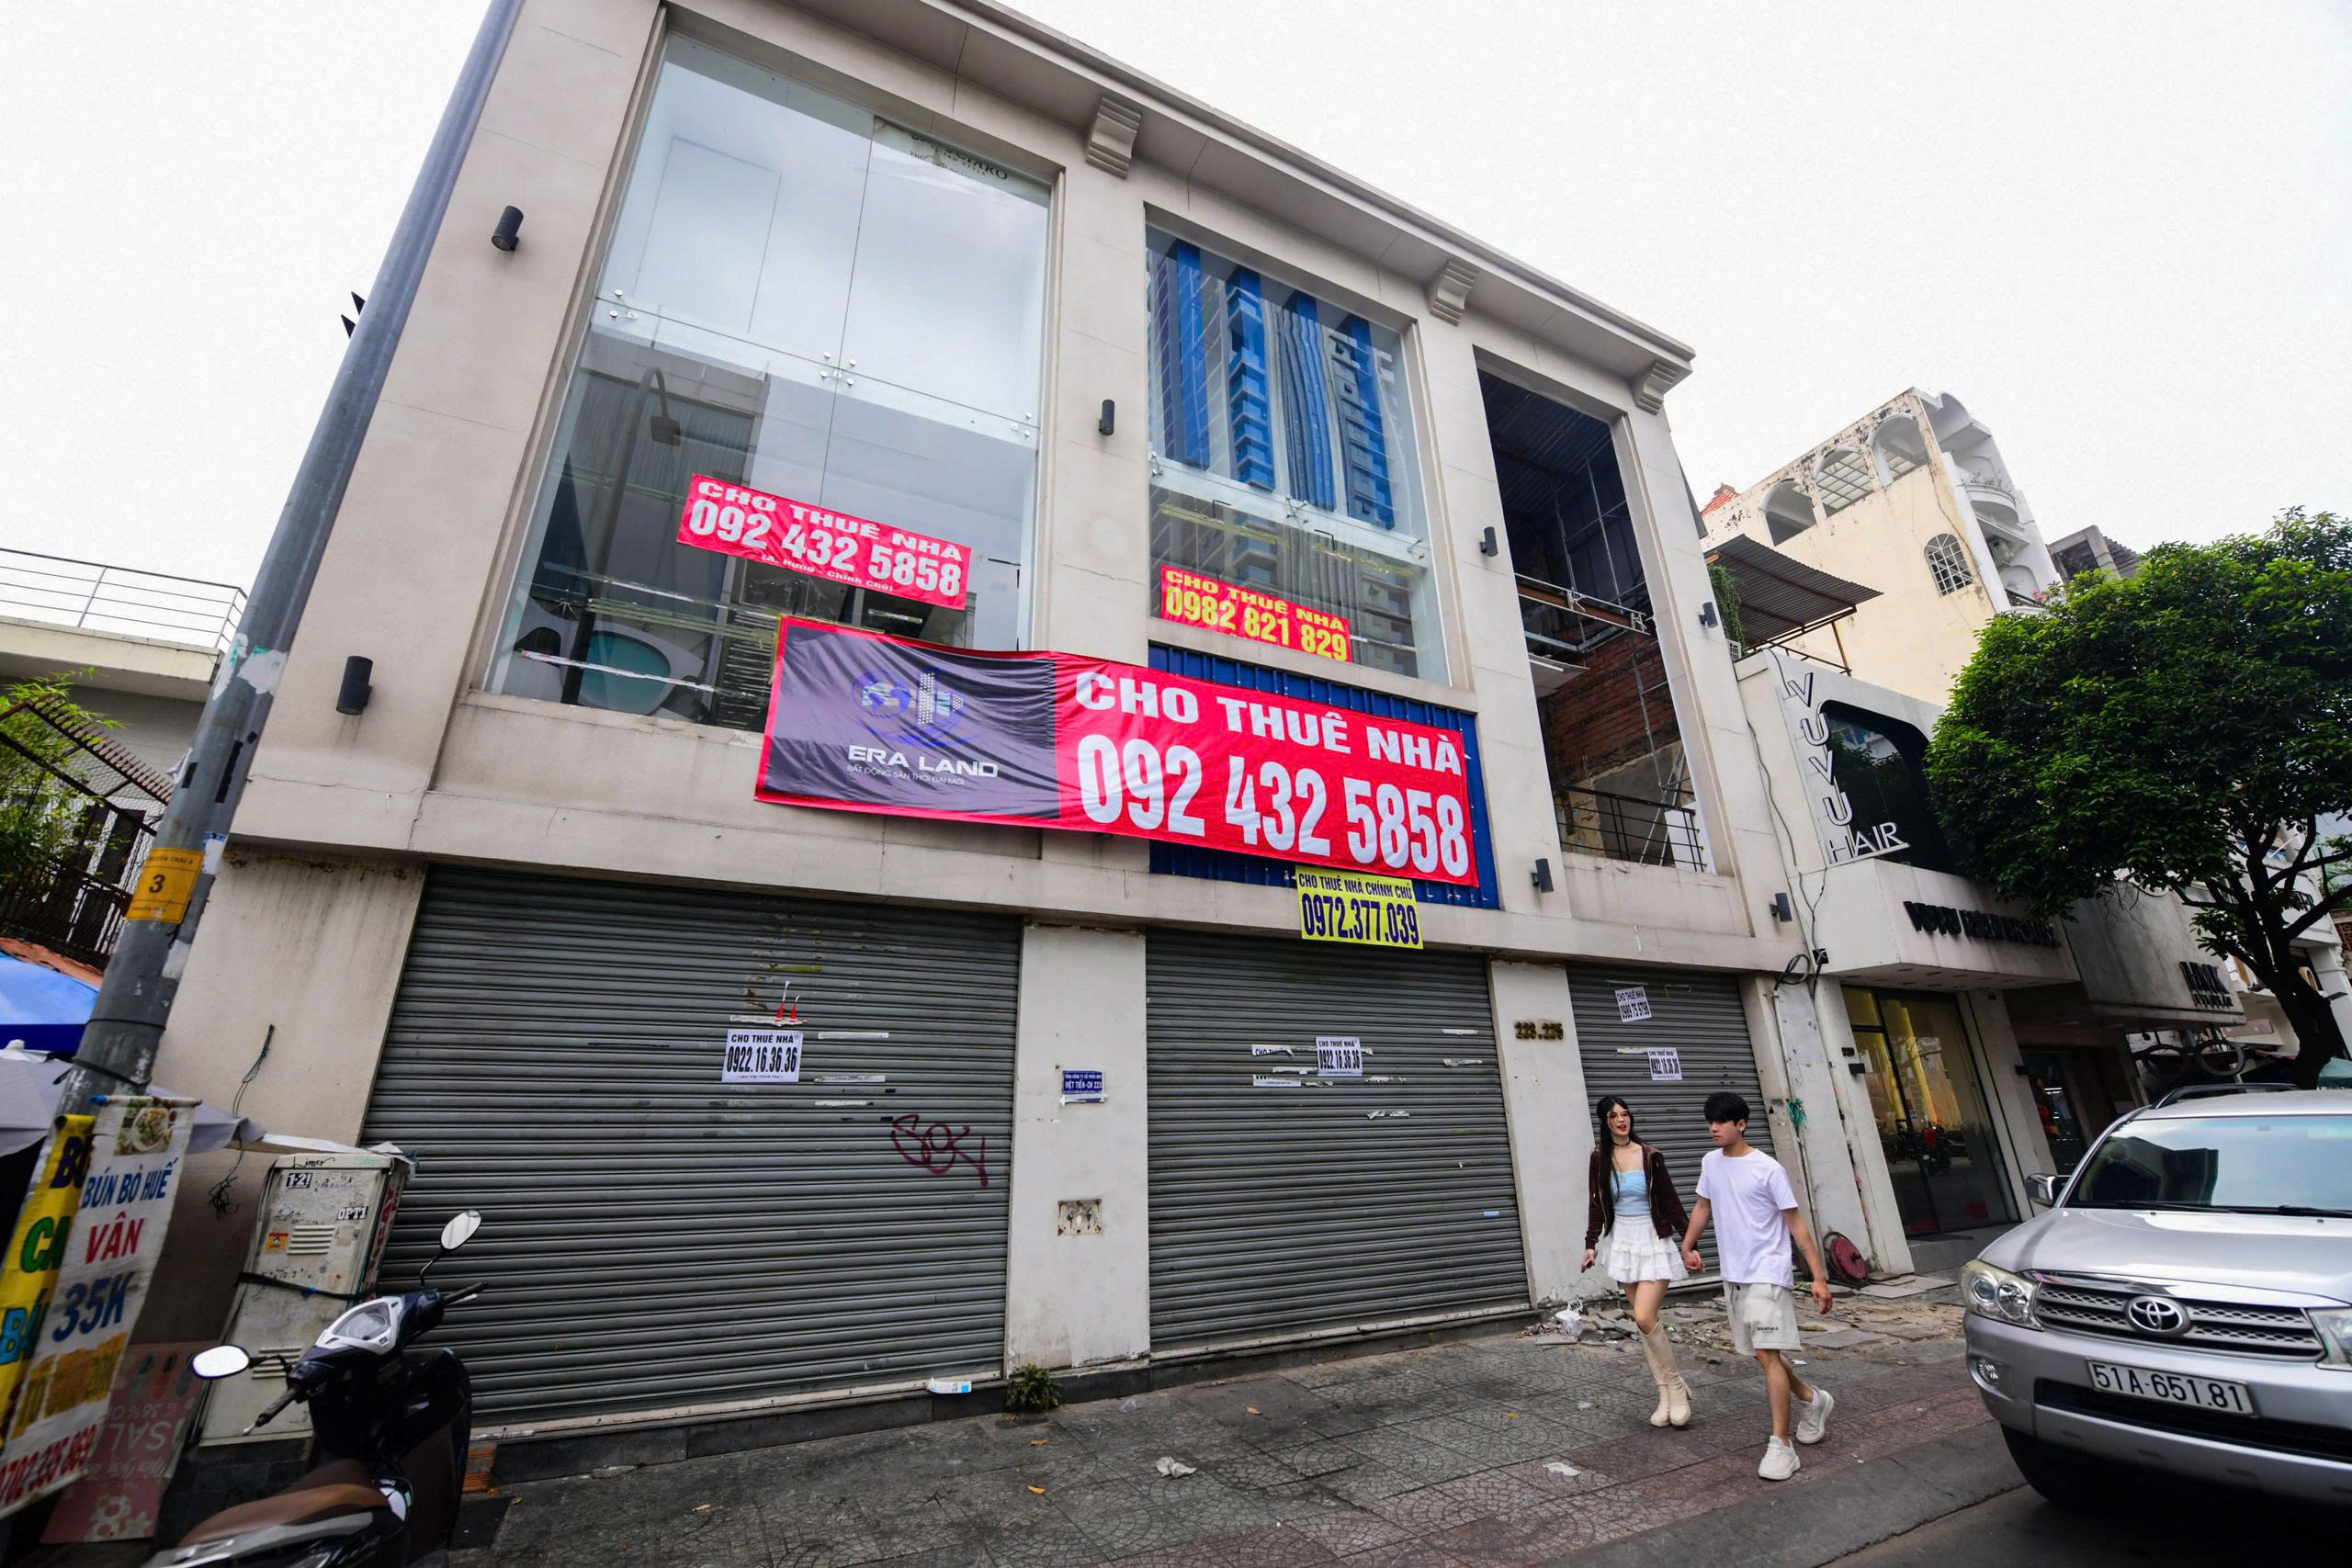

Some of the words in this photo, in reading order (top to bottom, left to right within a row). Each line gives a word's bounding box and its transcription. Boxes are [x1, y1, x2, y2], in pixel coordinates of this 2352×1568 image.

[689, 500, 772, 549] 092
[782, 524, 858, 572] 432
[868, 546, 961, 596] 5858
[698, 481, 776, 513] CHO
[789, 504, 880, 539] THUÊ
[891, 529, 963, 562] NHÀ
[1165, 570, 1219, 594] CHO
[1227, 587, 1289, 615] THUÊ
[1296, 608, 1345, 632] NHÀ
[1166, 586, 1236, 631] 0982
[1244, 607, 1290, 646] 821
[1300, 624, 1348, 661] 829
[1075, 671, 1199, 724] CHO
[1216, 695, 1351, 754] THUÊ
[1366, 726, 1463, 776] NHÀ
[1787, 672, 1853, 826] VUVU
[848, 745, 910, 767] ERA
[919, 756, 999, 777] LAND
[1077, 734, 1205, 838] 092
[1225, 755, 1330, 857] 432
[1343, 776, 1469, 877] 5858
[1828, 822, 1908, 864] HAIR
[149, 874, 165, 893] 3
[1299, 873, 1317, 888] CHO
[1319, 874, 1343, 891] THUÊ
[1344, 877, 1364, 894] NHÀ
[1365, 880, 1393, 897] CHÍNH
[1395, 882, 1413, 899] CHỦ
[1302, 893, 1419, 945] 0972.377.039
[727, 1045, 797, 1073] 0922.16.36.36
[731, 1034, 750, 1043] CHO
[752, 1032, 774, 1043] THUÊ
[776, 1033, 794, 1043] NHÀ
[81, 1167, 119, 1209] BÚN
[117, 1165, 142, 1204] BÒ
[140, 1157, 178, 1201] HUẾ
[85, 1211, 144, 1265] VÂN
[52, 1270, 134, 1342] 35K
[2093, 1364, 2244, 1412] 51A-651.81
